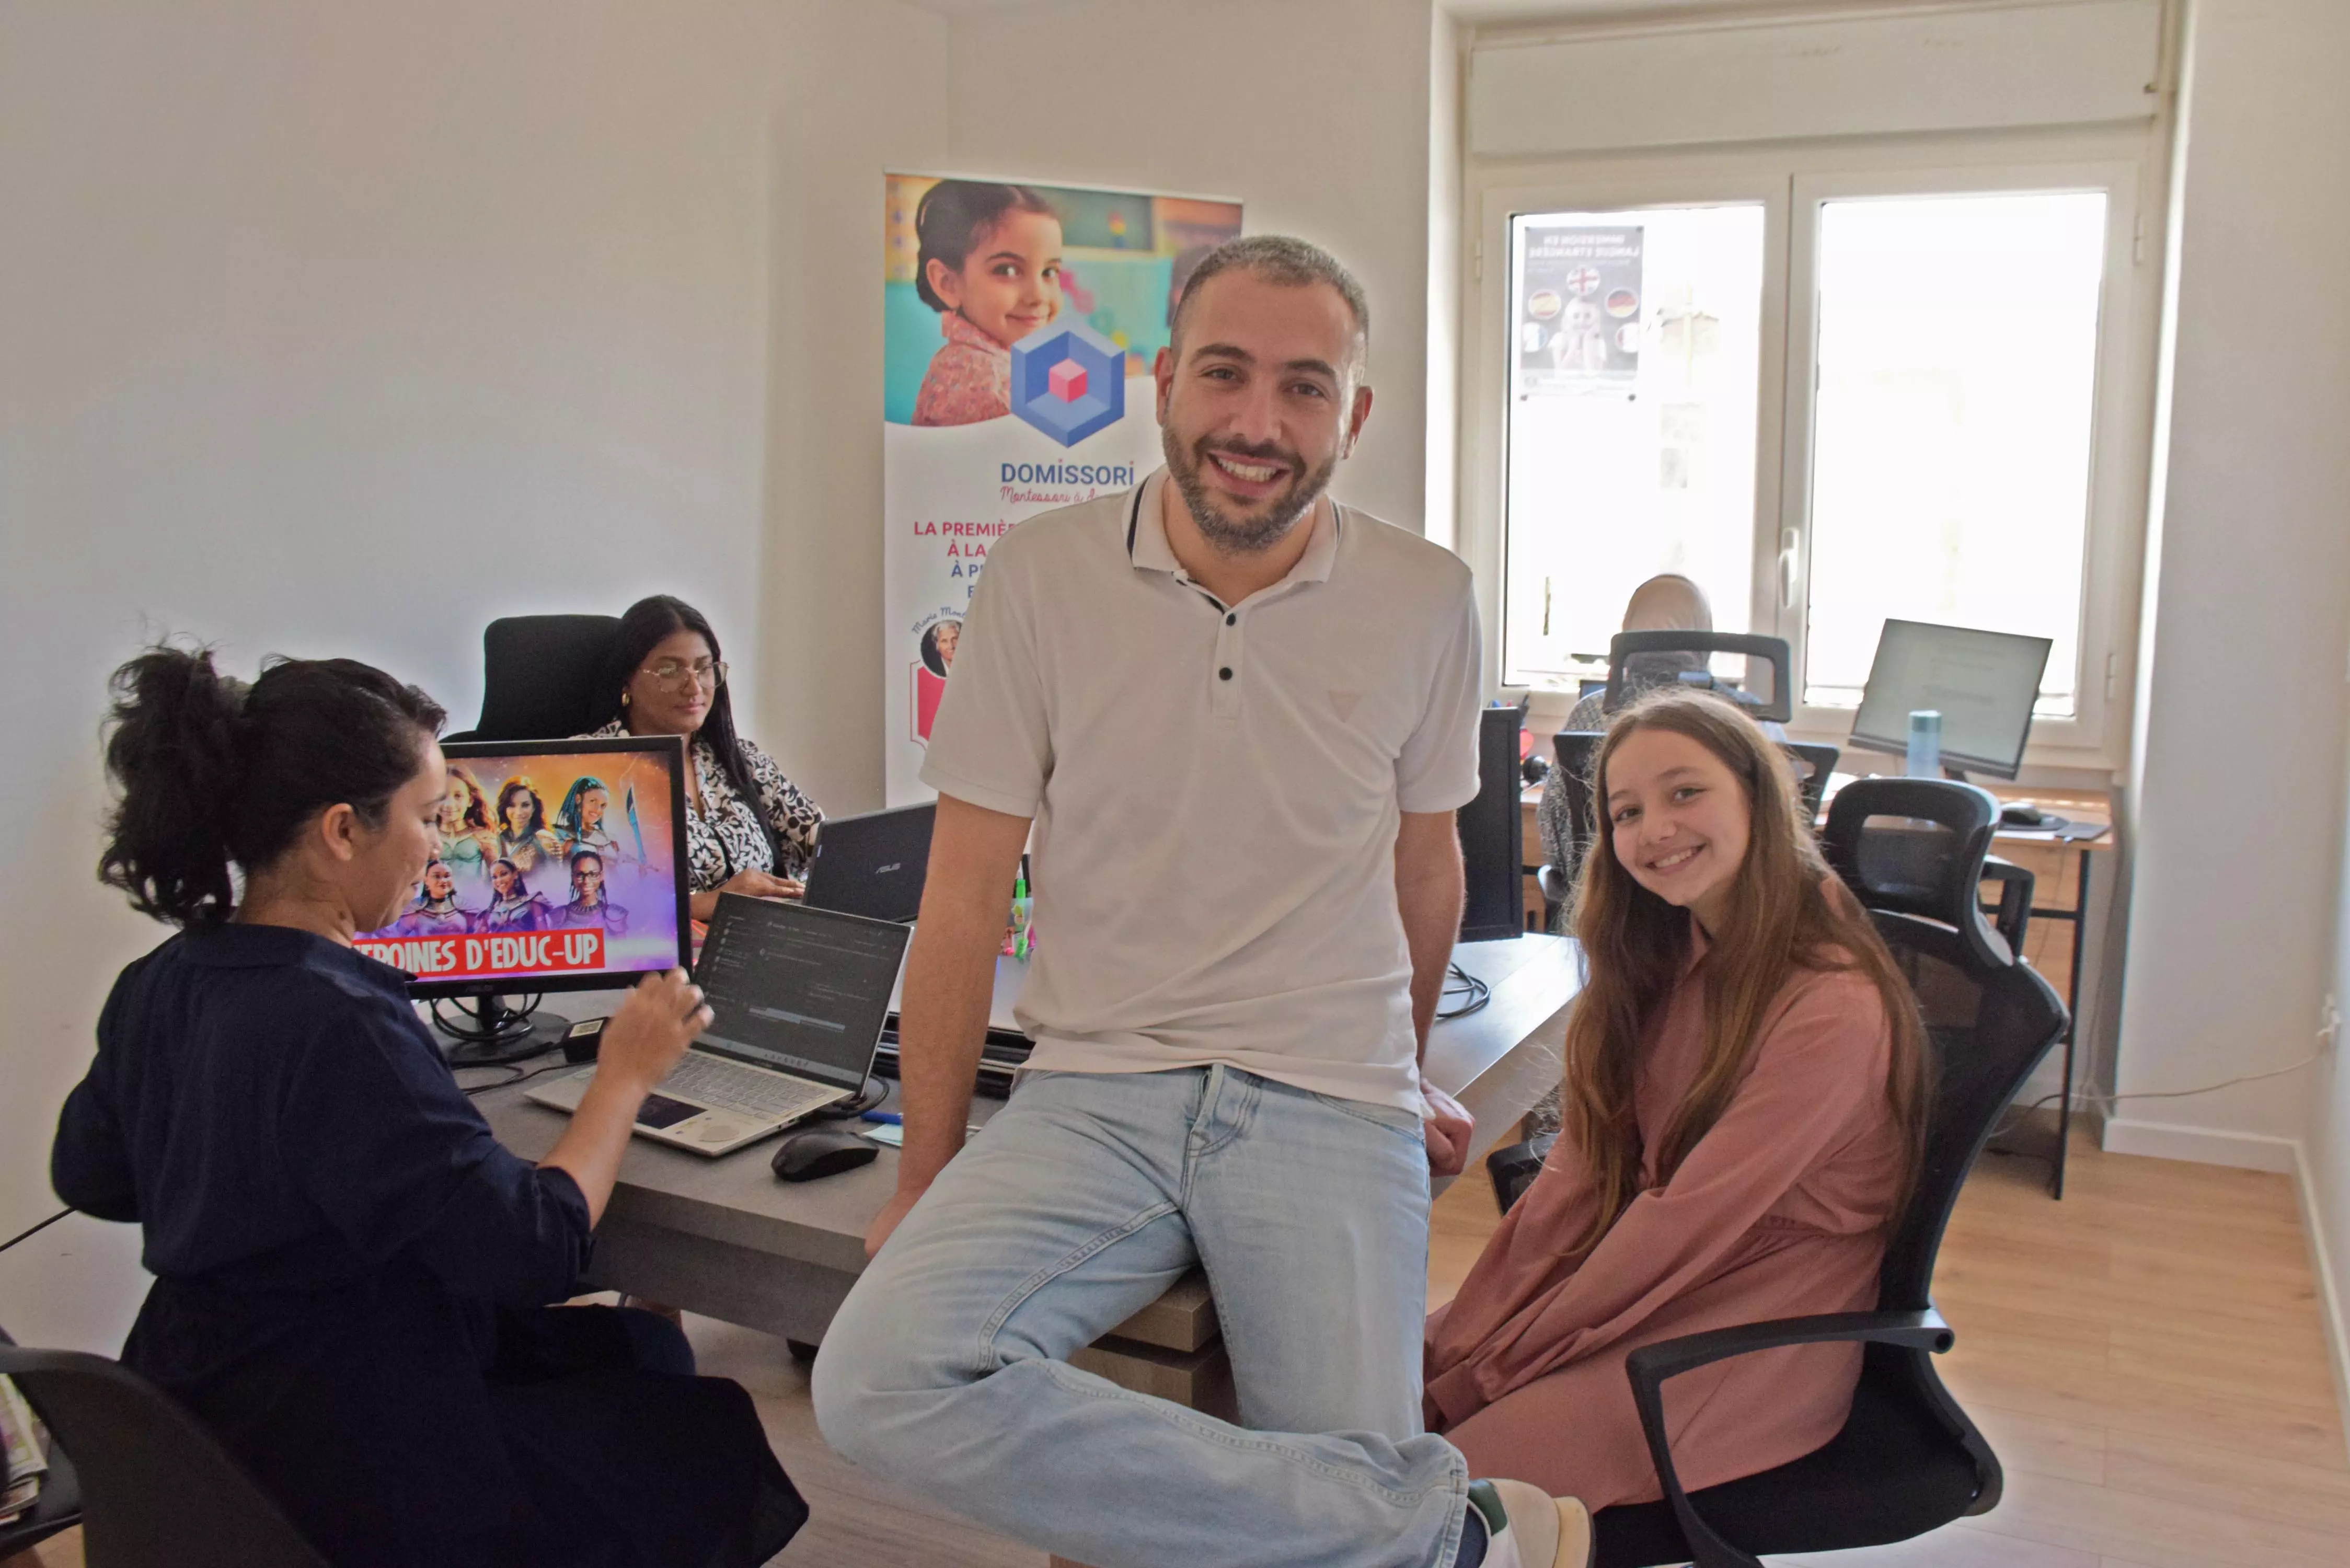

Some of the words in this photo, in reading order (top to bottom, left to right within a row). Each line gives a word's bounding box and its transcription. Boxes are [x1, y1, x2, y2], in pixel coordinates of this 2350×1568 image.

[1000, 485, 1072, 503] Montessori
[1074, 490, 1084, 502] à
[914, 521, 937, 536] LA
[947, 538, 960, 557] À
[964, 543, 987, 557] LA
[951, 559, 963, 578] À
[465, 932, 598, 971] D'EDUC-UP
